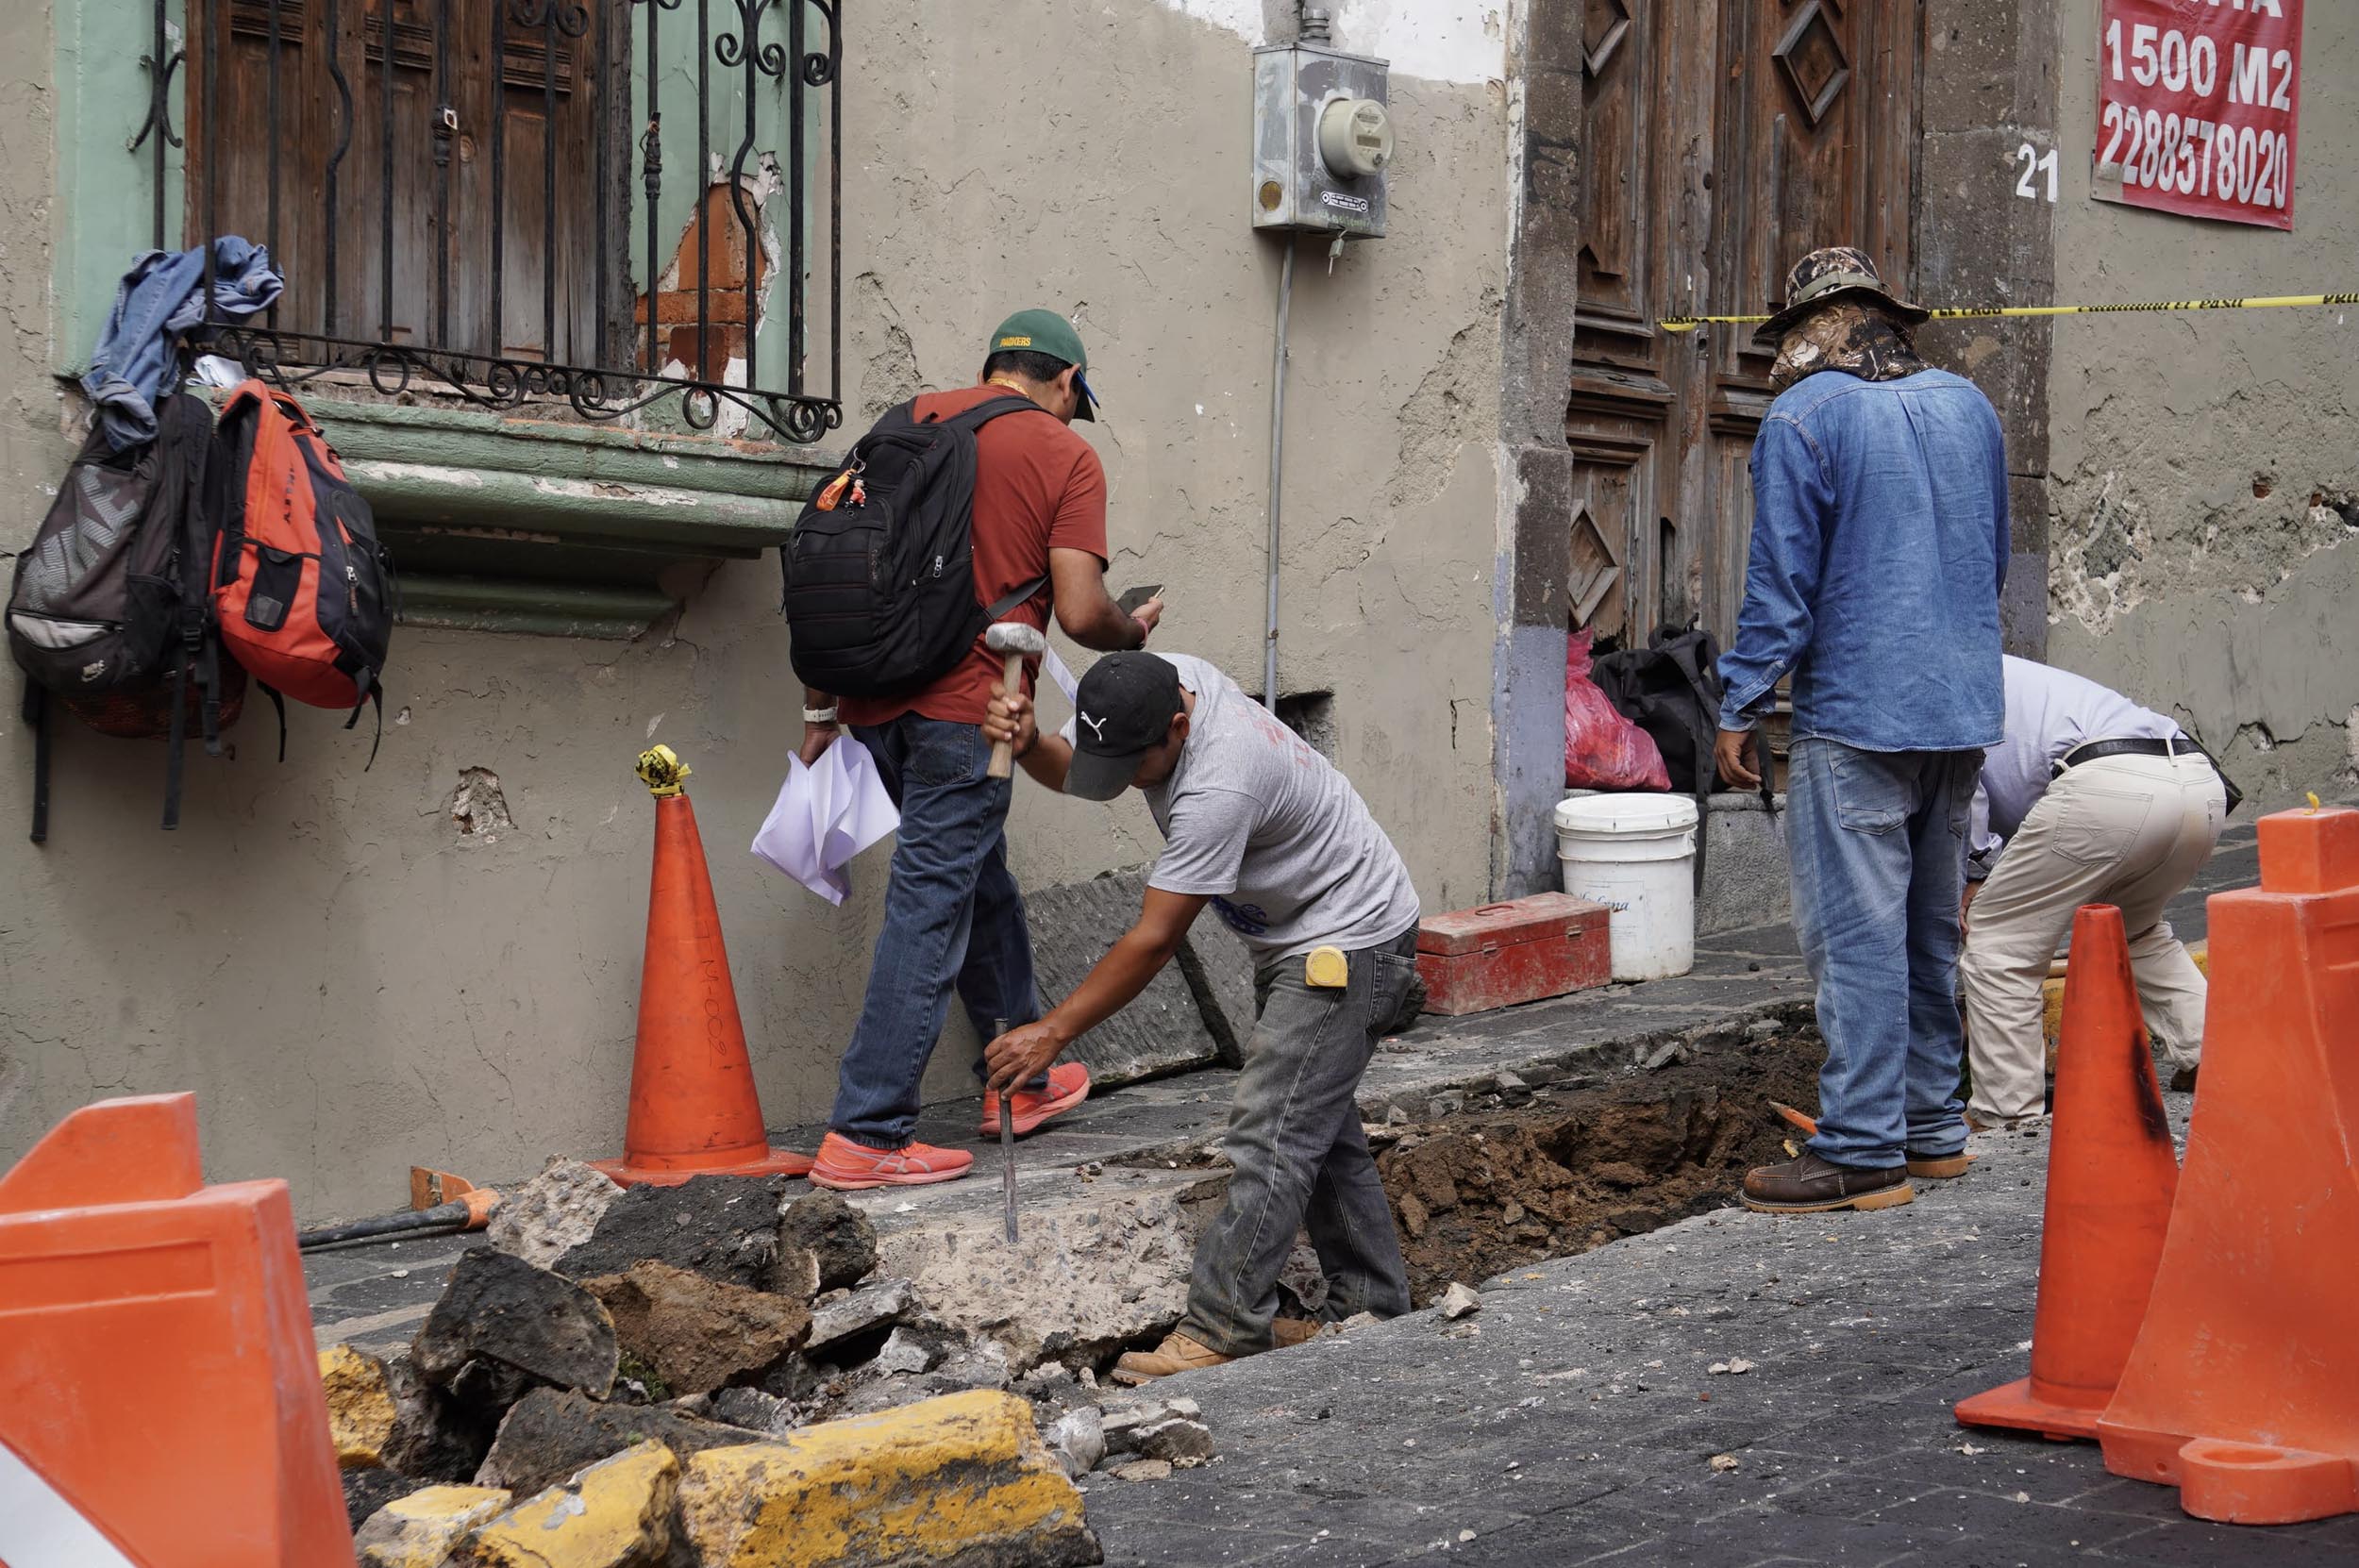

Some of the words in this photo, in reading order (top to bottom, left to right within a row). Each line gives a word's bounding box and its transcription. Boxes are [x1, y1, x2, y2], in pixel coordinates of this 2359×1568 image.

[2106, 19, 2217, 97] 1500
[2228, 42, 2293, 111] M2
[2016, 143, 2058, 203] 21
[2098, 101, 2288, 209] 2288578020
[1000, 336, 1031, 347] PACKERS
[21, 463, 140, 612] NIKE
